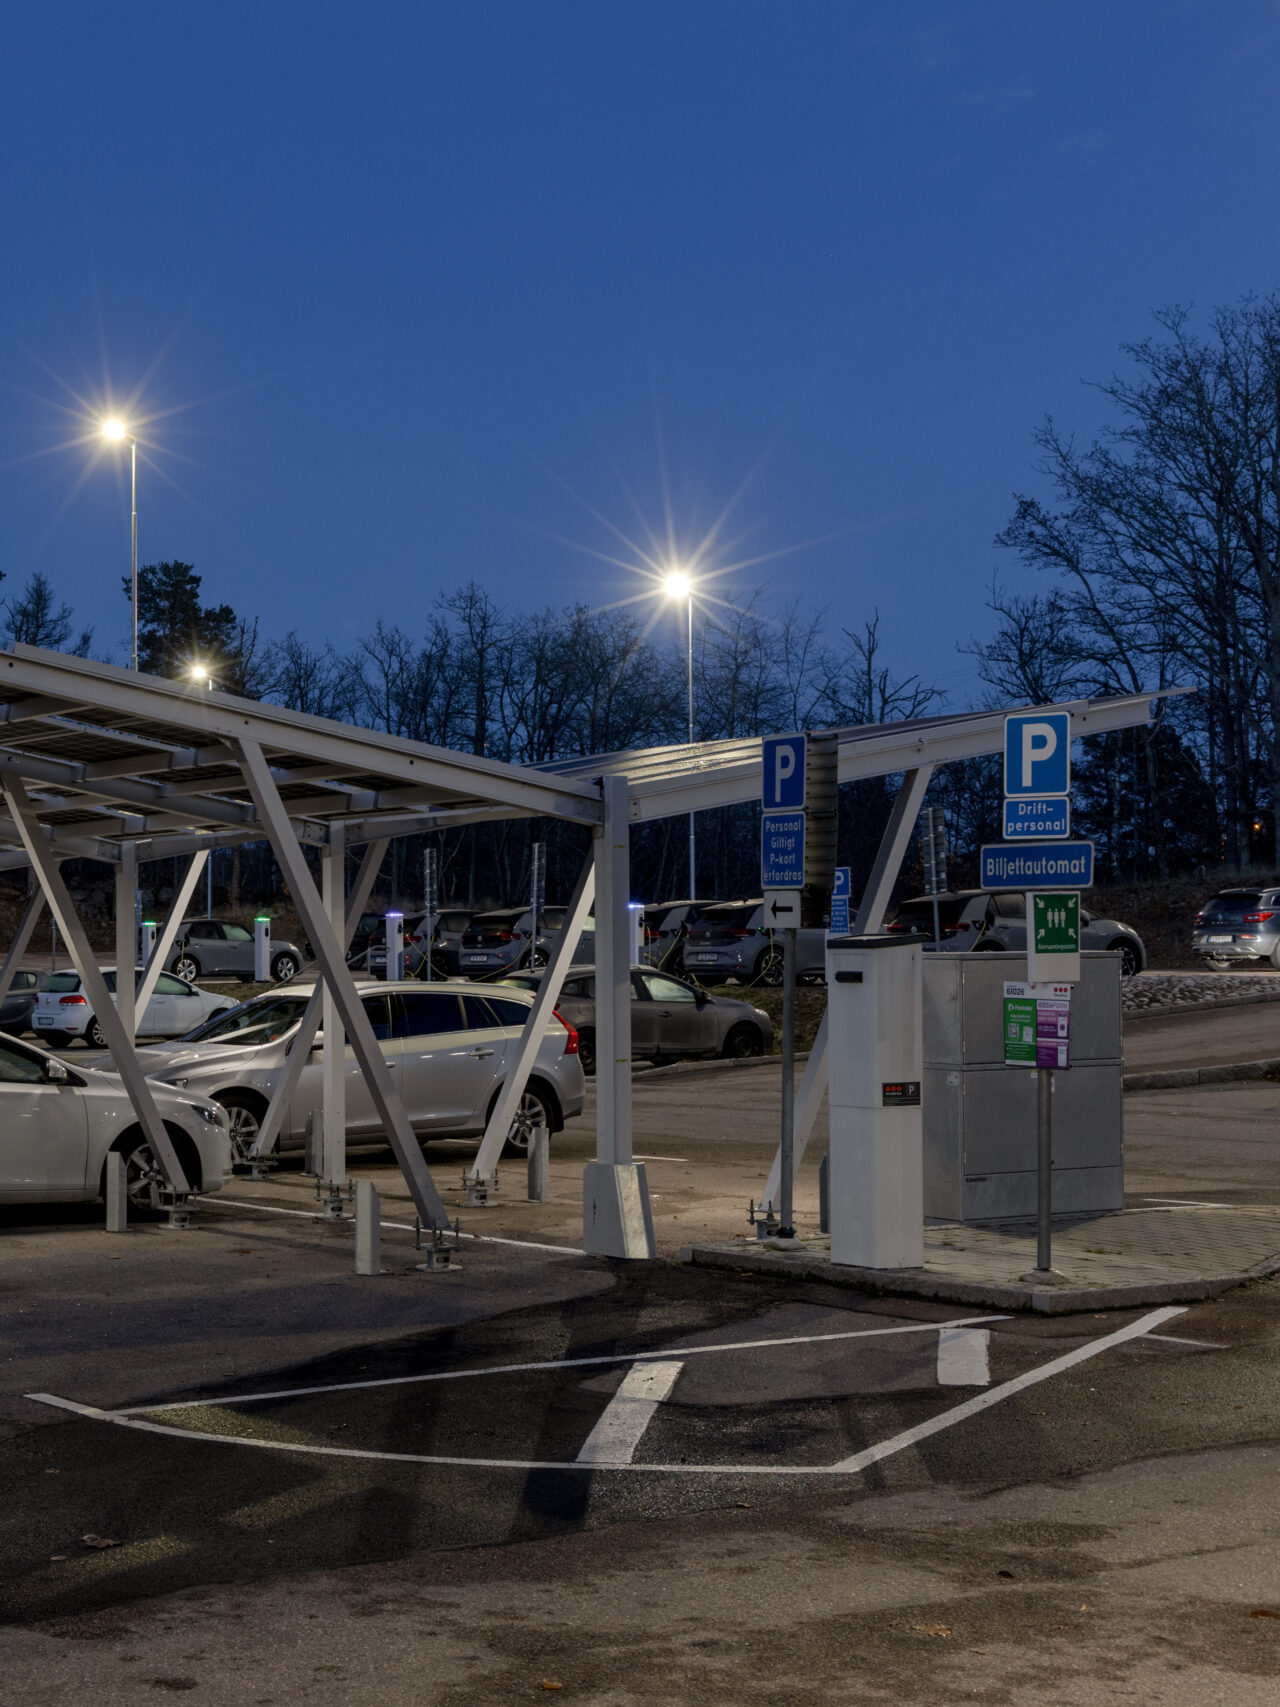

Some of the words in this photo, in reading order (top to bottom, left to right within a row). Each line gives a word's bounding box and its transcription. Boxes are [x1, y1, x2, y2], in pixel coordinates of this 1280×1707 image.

[1022, 723, 1057, 787] P
[775, 745, 795, 802] P
[1019, 803, 1053, 815] Drift-
[766, 819, 801, 832] Personal
[1008, 818, 1065, 834] personal
[771, 836, 795, 850] Giltigt
[770, 853, 795, 864] P-kort
[763, 869, 802, 881] erfordras
[987, 856, 1086, 880] Biljettautomat
[833, 871, 844, 894] P
